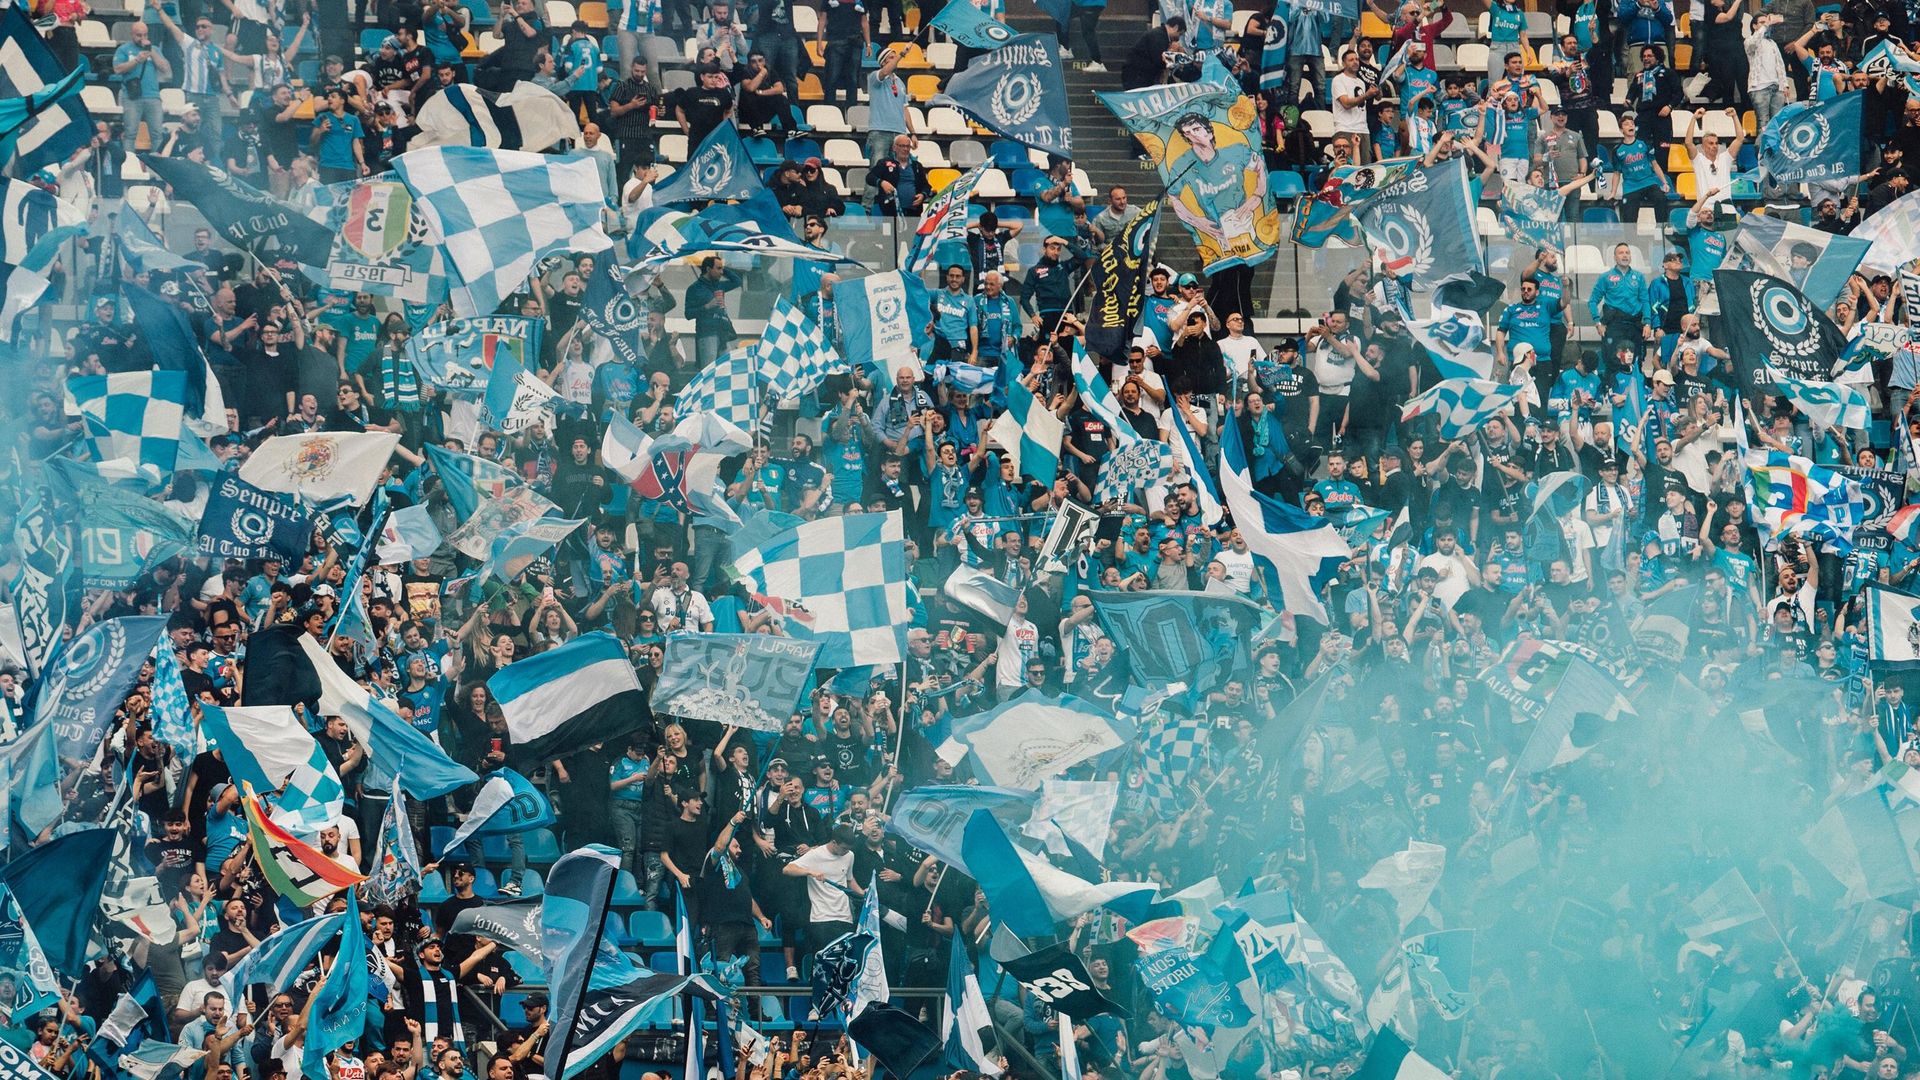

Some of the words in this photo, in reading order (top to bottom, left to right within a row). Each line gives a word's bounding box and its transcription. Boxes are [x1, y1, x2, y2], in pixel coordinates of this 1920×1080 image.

[1140, 161, 1155, 170] FILA
[251, 213, 288, 233] Tuo
[1433, 321, 1459, 338] 10
[1084, 421, 1104, 432] Lete
[219, 478, 303, 524] Sempre
[82, 527, 122, 566] 19
[199, 535, 216, 554] Al
[219, 540, 250, 558] Tuo
[415, 706, 431, 717] ete
[417, 717, 432, 725] MSC
[1151, 963, 1200, 996] STORIA
[339, 1067, 364, 1080] Lete
